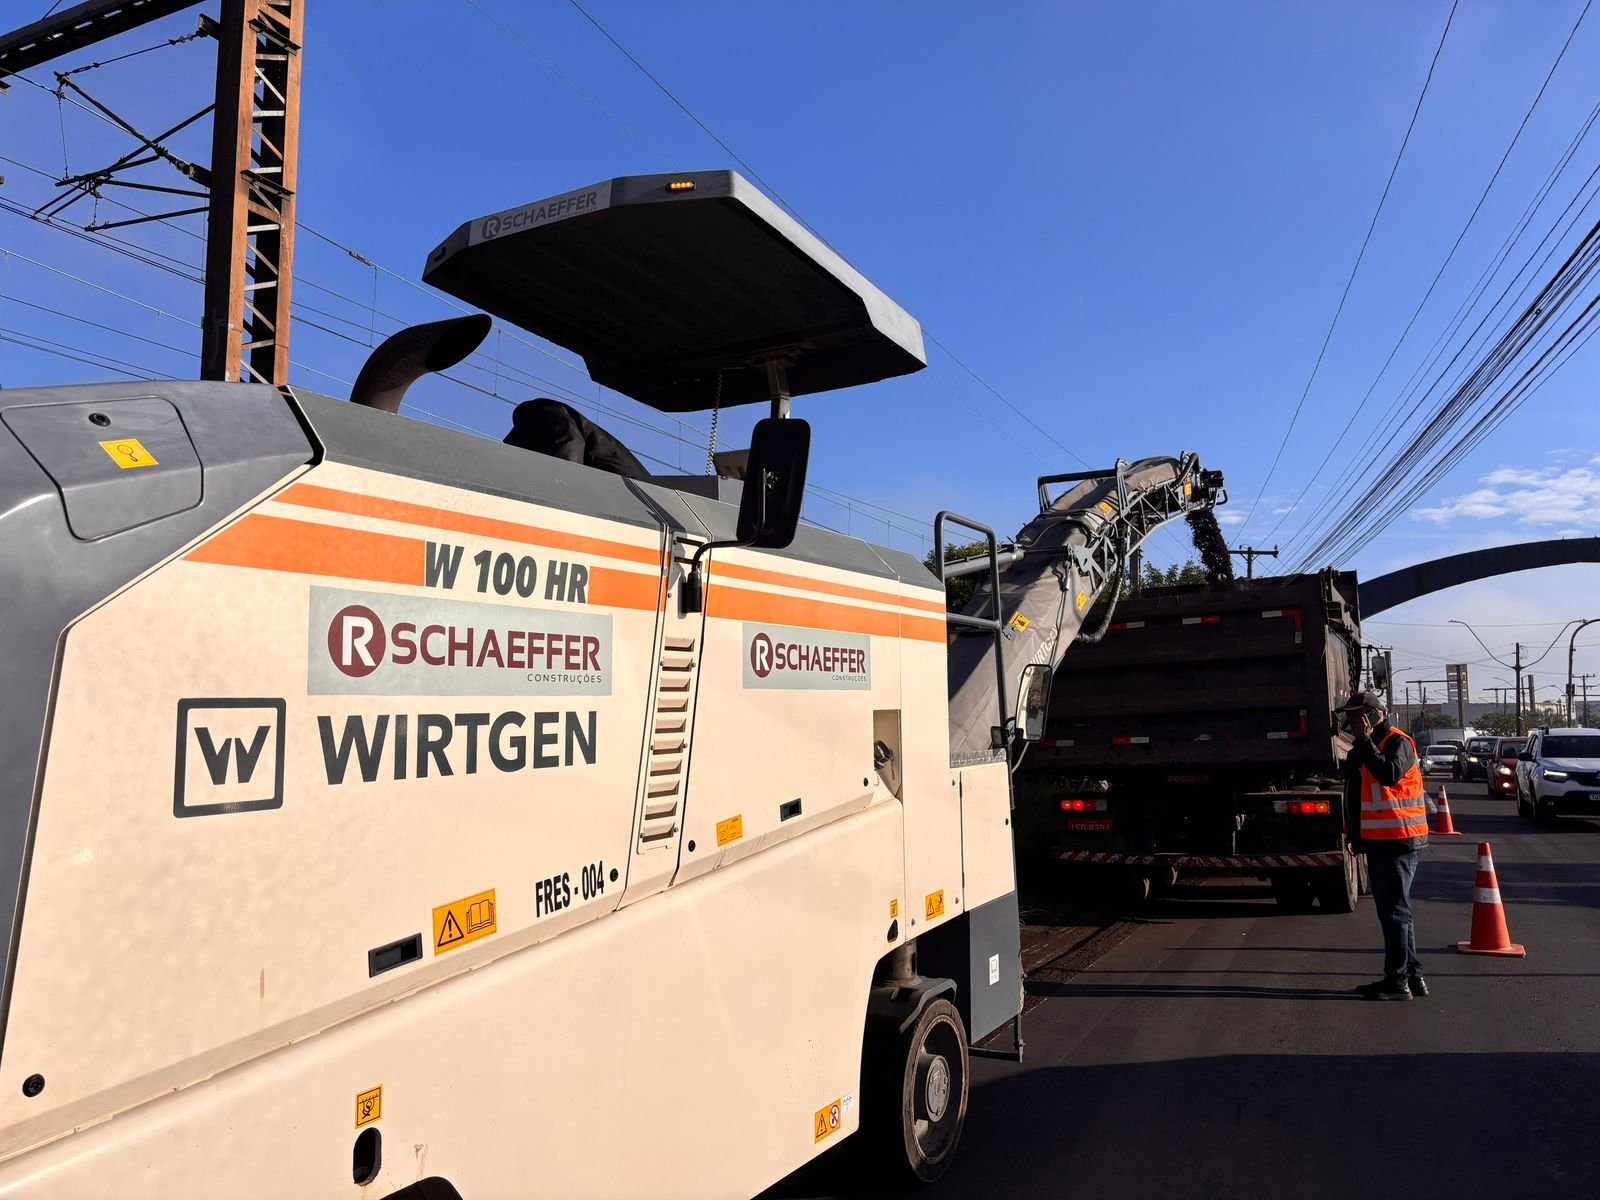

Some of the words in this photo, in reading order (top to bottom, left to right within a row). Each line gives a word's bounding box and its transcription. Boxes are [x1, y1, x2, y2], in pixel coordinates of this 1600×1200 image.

[502, 191, 598, 232] SCHAEFFER
[425, 541, 465, 589] W
[473, 550, 538, 598] 100
[544, 559, 589, 604] HR
[391, 622, 602, 671] SCHAEFFER
[775, 642, 866, 673] SCHAEFFER
[316, 710, 598, 786] WIRTGEN
[535, 872, 571, 918] FRES
[582, 860, 604, 900] 004
